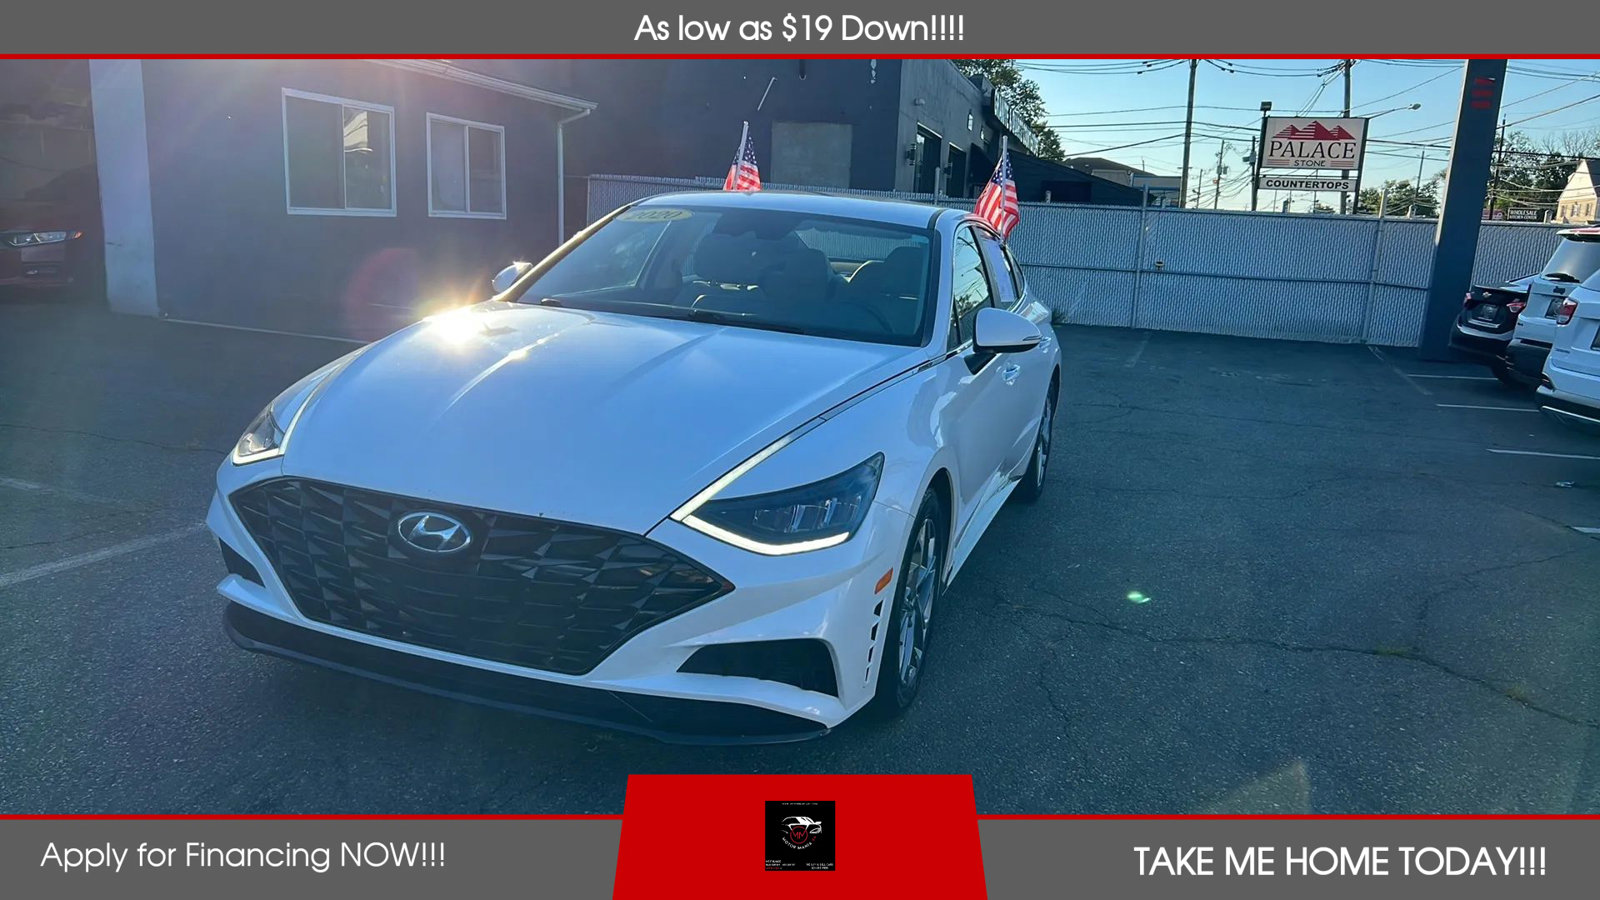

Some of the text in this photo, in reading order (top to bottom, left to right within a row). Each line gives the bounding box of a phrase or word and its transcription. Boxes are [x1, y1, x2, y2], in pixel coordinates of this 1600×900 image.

[1268, 140, 1356, 159] PALACE
[1294, 159, 1326, 167] STONE
[1266, 179, 1349, 190] COUNTERTOPS
